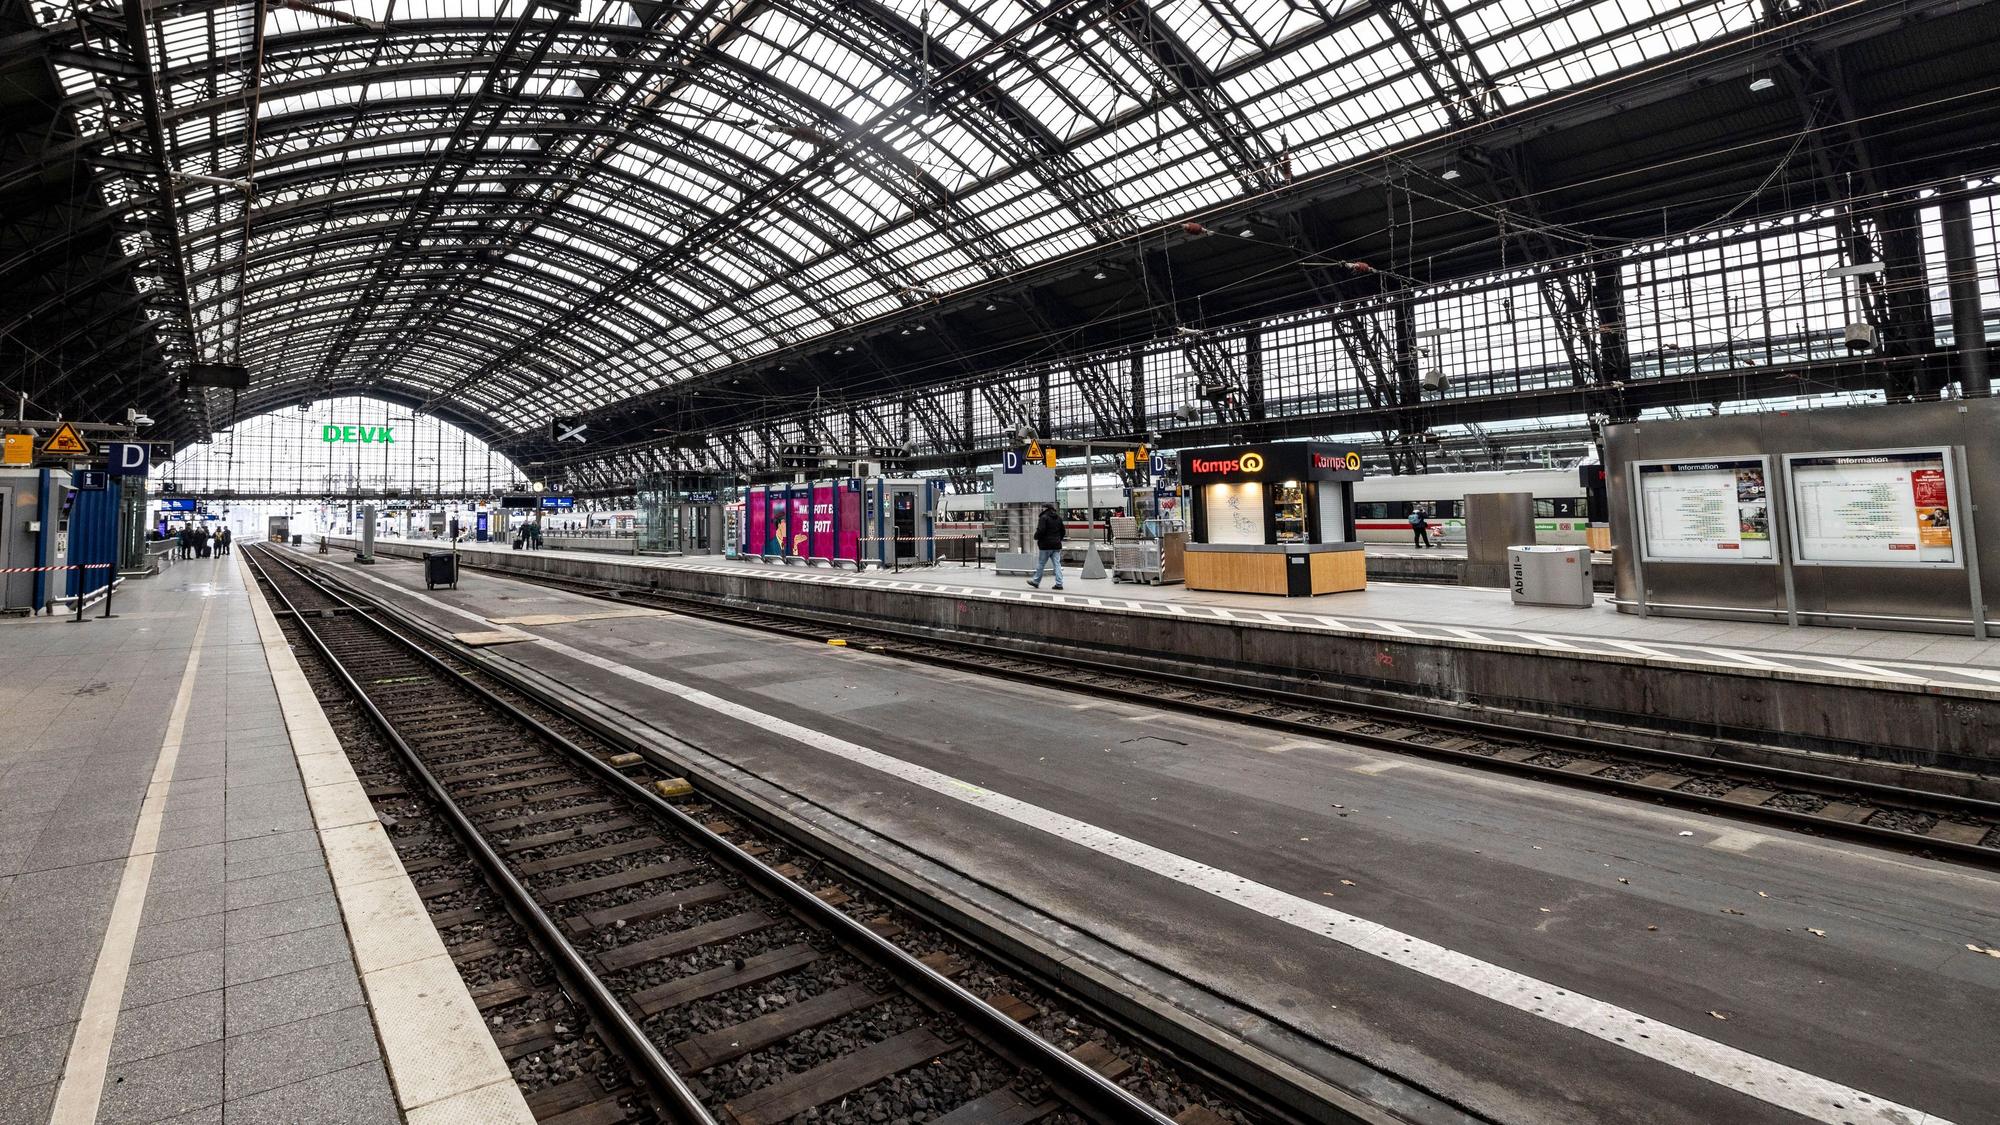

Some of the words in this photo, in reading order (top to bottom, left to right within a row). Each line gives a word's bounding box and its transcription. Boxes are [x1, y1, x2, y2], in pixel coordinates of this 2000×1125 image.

[323, 425, 395, 443] DEVK
[122, 444, 145, 468] D
[1007, 452, 1017, 469] D
[1155, 456, 1163, 472] D
[1314, 452, 1346, 471] Kamps
[1192, 459, 1239, 475] Kamps
[168, 483, 175, 491] 3
[1561, 504, 1568, 512] 2
[1514, 564, 1524, 594] Abfall
